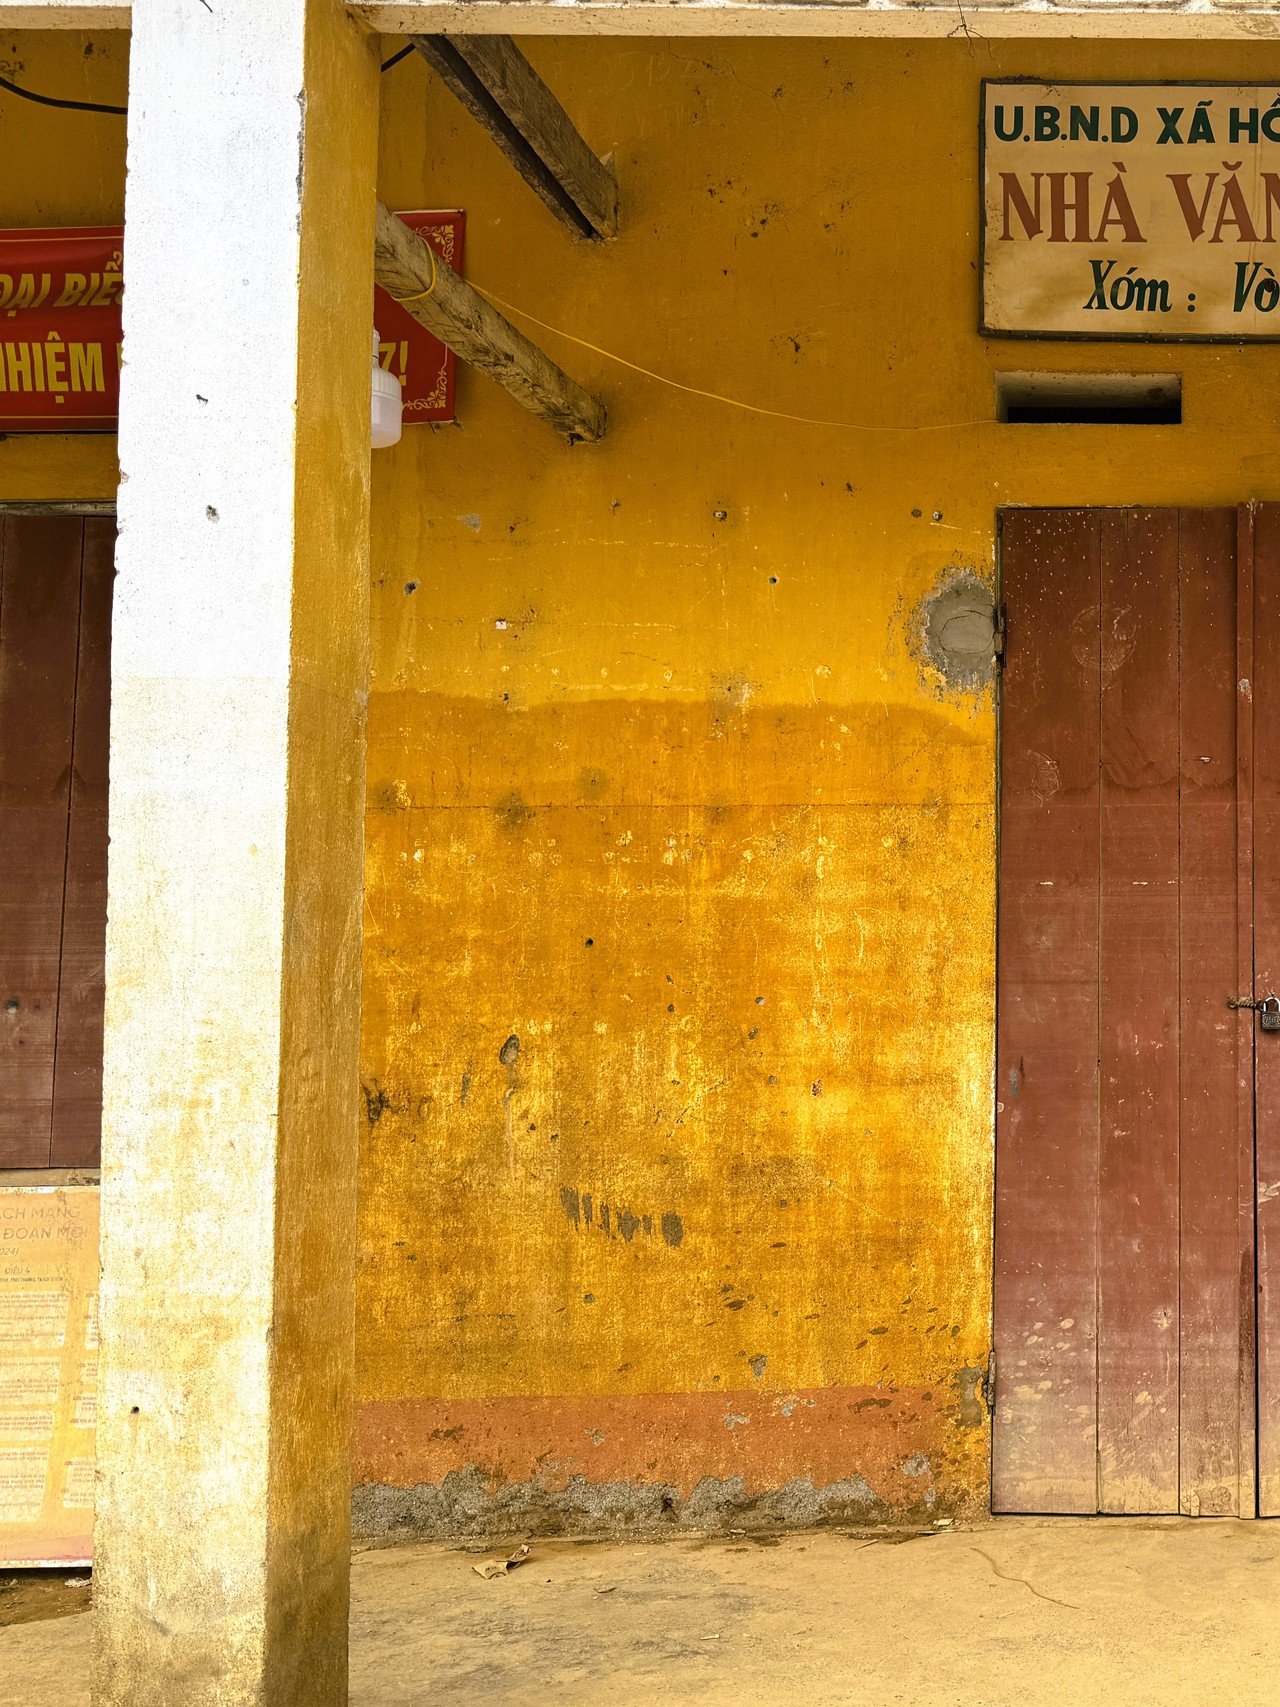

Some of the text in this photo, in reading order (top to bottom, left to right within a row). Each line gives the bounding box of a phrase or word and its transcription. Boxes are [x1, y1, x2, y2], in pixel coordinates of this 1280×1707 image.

[994, 105, 1139, 144] U.B.N.D
[1156, 100, 1216, 145] XÃ
[997, 161, 1148, 243] NHÀ
[53, 251, 124, 308] BIỂ
[1082, 259, 1173, 313] Xóm
[1233, 261, 1280, 313] Vò
[3, 1226, 52, 1243] ĐOẠN
